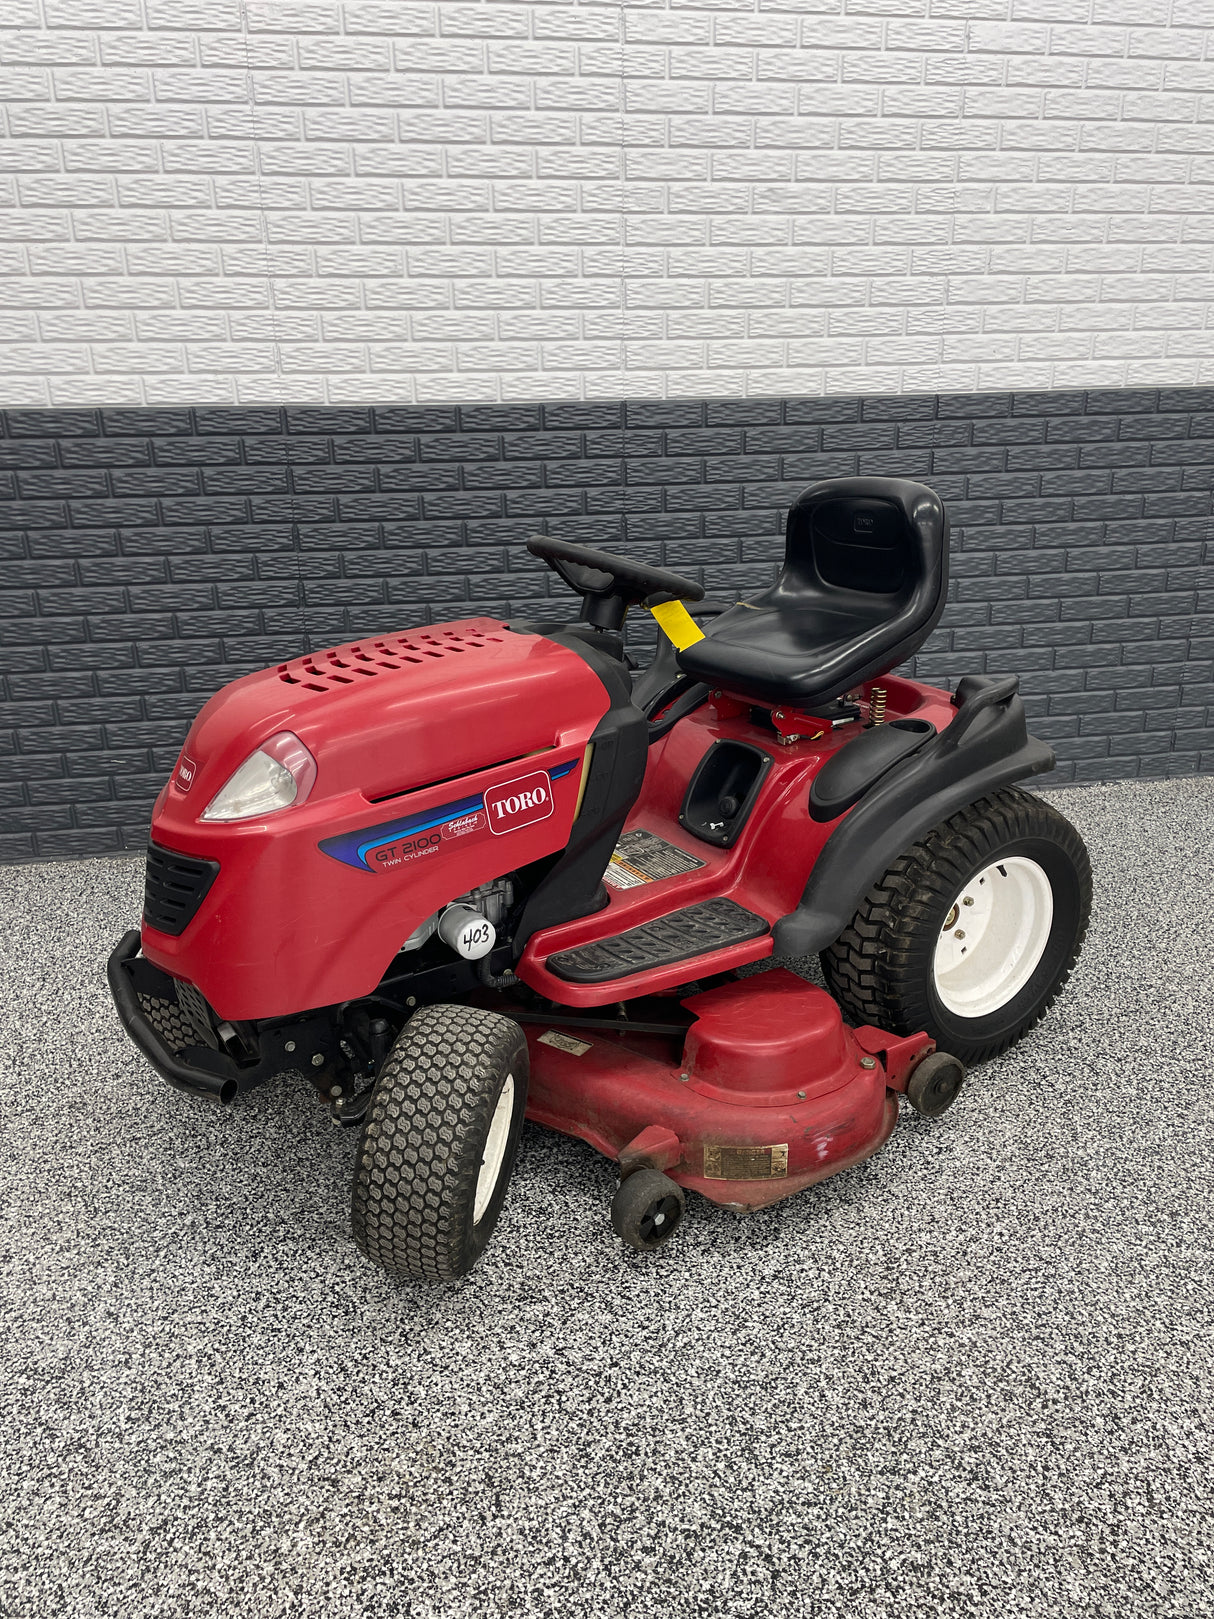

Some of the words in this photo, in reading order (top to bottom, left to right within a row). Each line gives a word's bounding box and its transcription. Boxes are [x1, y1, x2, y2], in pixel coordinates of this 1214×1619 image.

[491, 787, 546, 819] TORO
[375, 846, 397, 862] GT
[402, 833, 442, 854] 2100
[382, 857, 402, 868] TWIN
[403, 845, 439, 861] CYLINDER
[463, 923, 490, 952] 403
